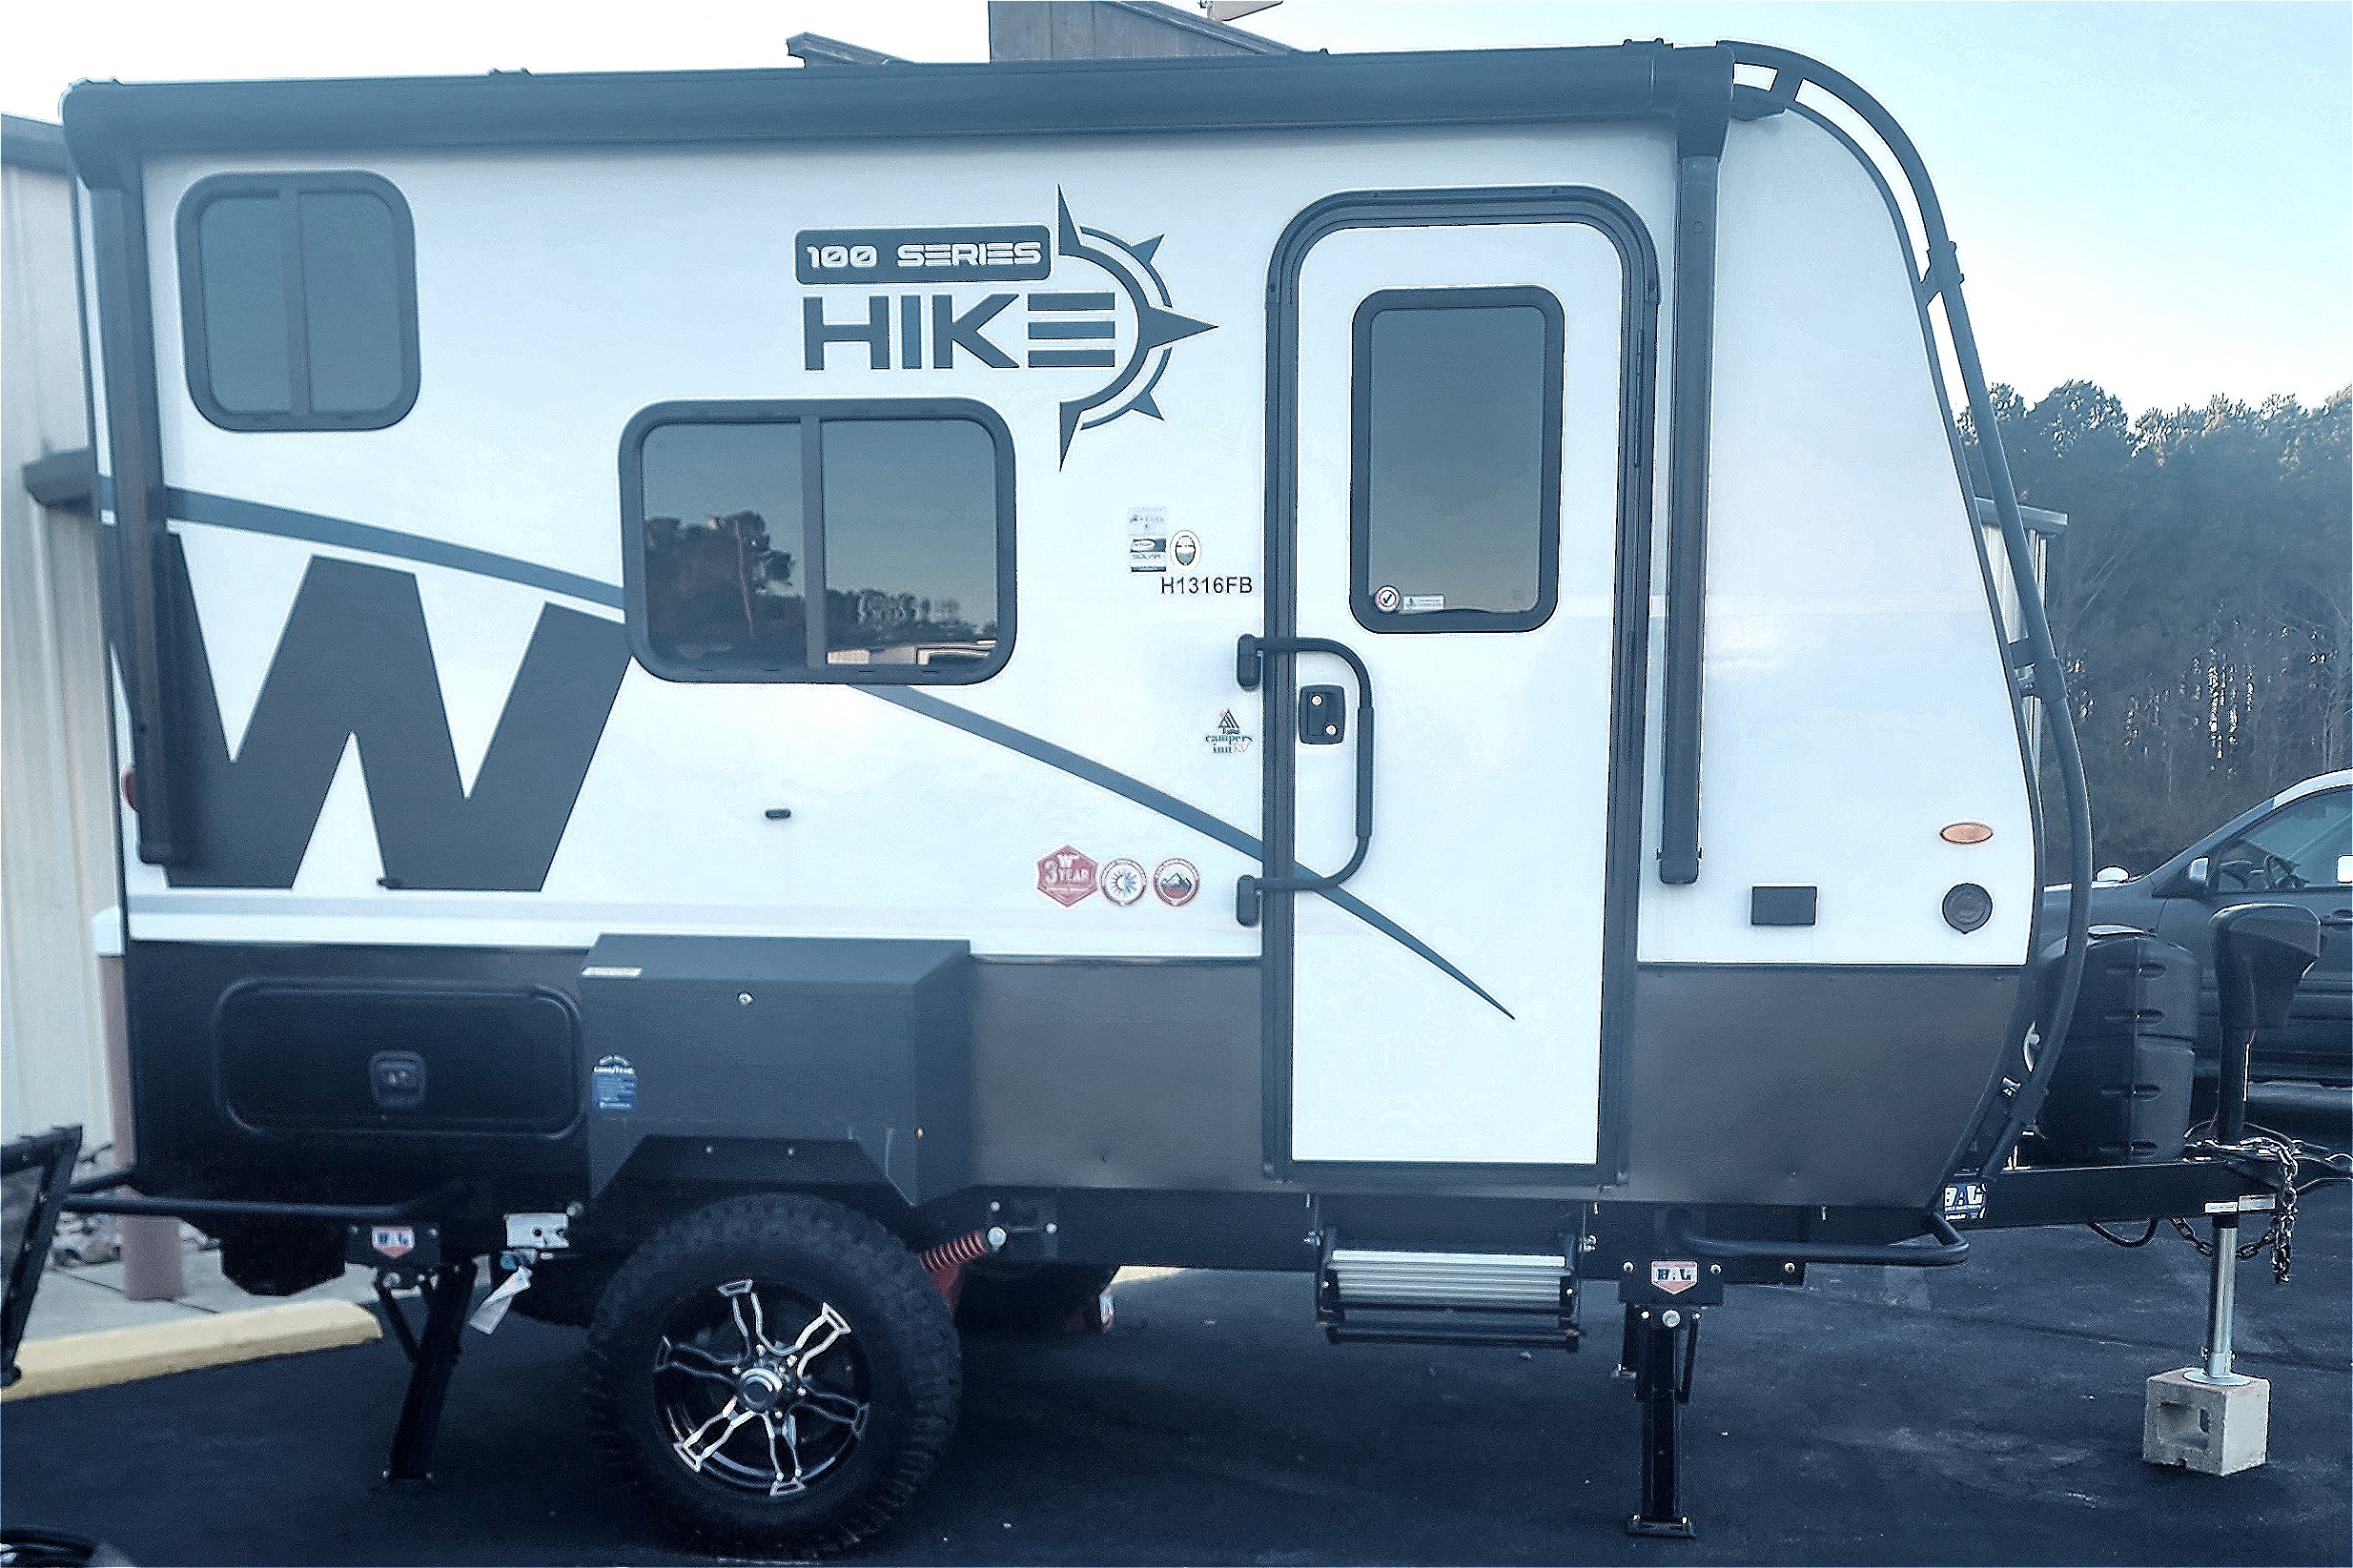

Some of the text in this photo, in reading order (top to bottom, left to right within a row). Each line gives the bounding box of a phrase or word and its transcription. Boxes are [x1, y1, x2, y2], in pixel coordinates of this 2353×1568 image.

[806, 240, 1042, 269] 100 SERIES
[803, 292, 1116, 371] HIKE
[1160, 576, 1253, 595] H1316FB
